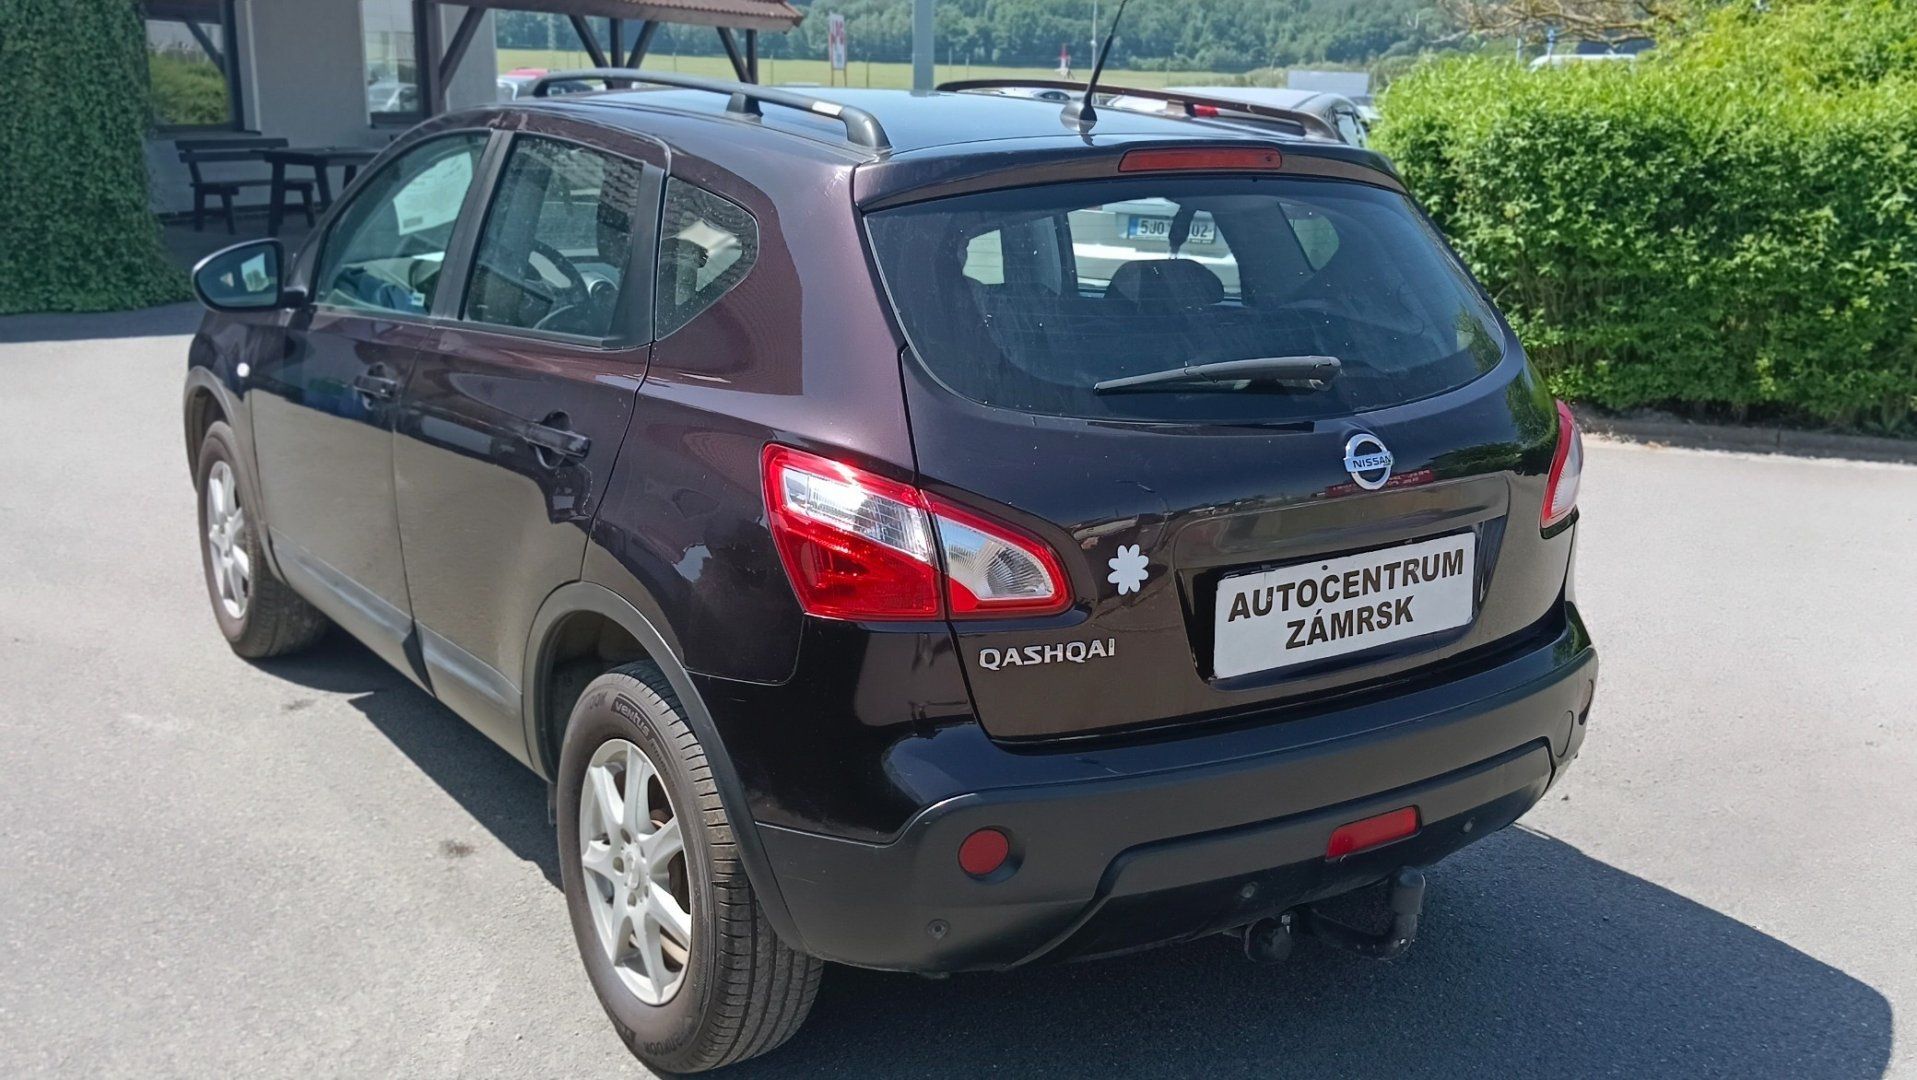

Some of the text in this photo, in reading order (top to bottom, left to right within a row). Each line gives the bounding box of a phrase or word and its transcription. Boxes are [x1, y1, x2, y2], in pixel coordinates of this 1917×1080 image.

[1352, 455, 1391, 468] NISSAN
[1228, 548, 1464, 623] AUTOCENTRUM
[1285, 595, 1414, 650] ZÁMRSK
[979, 638, 1116, 671] QASHQAI
